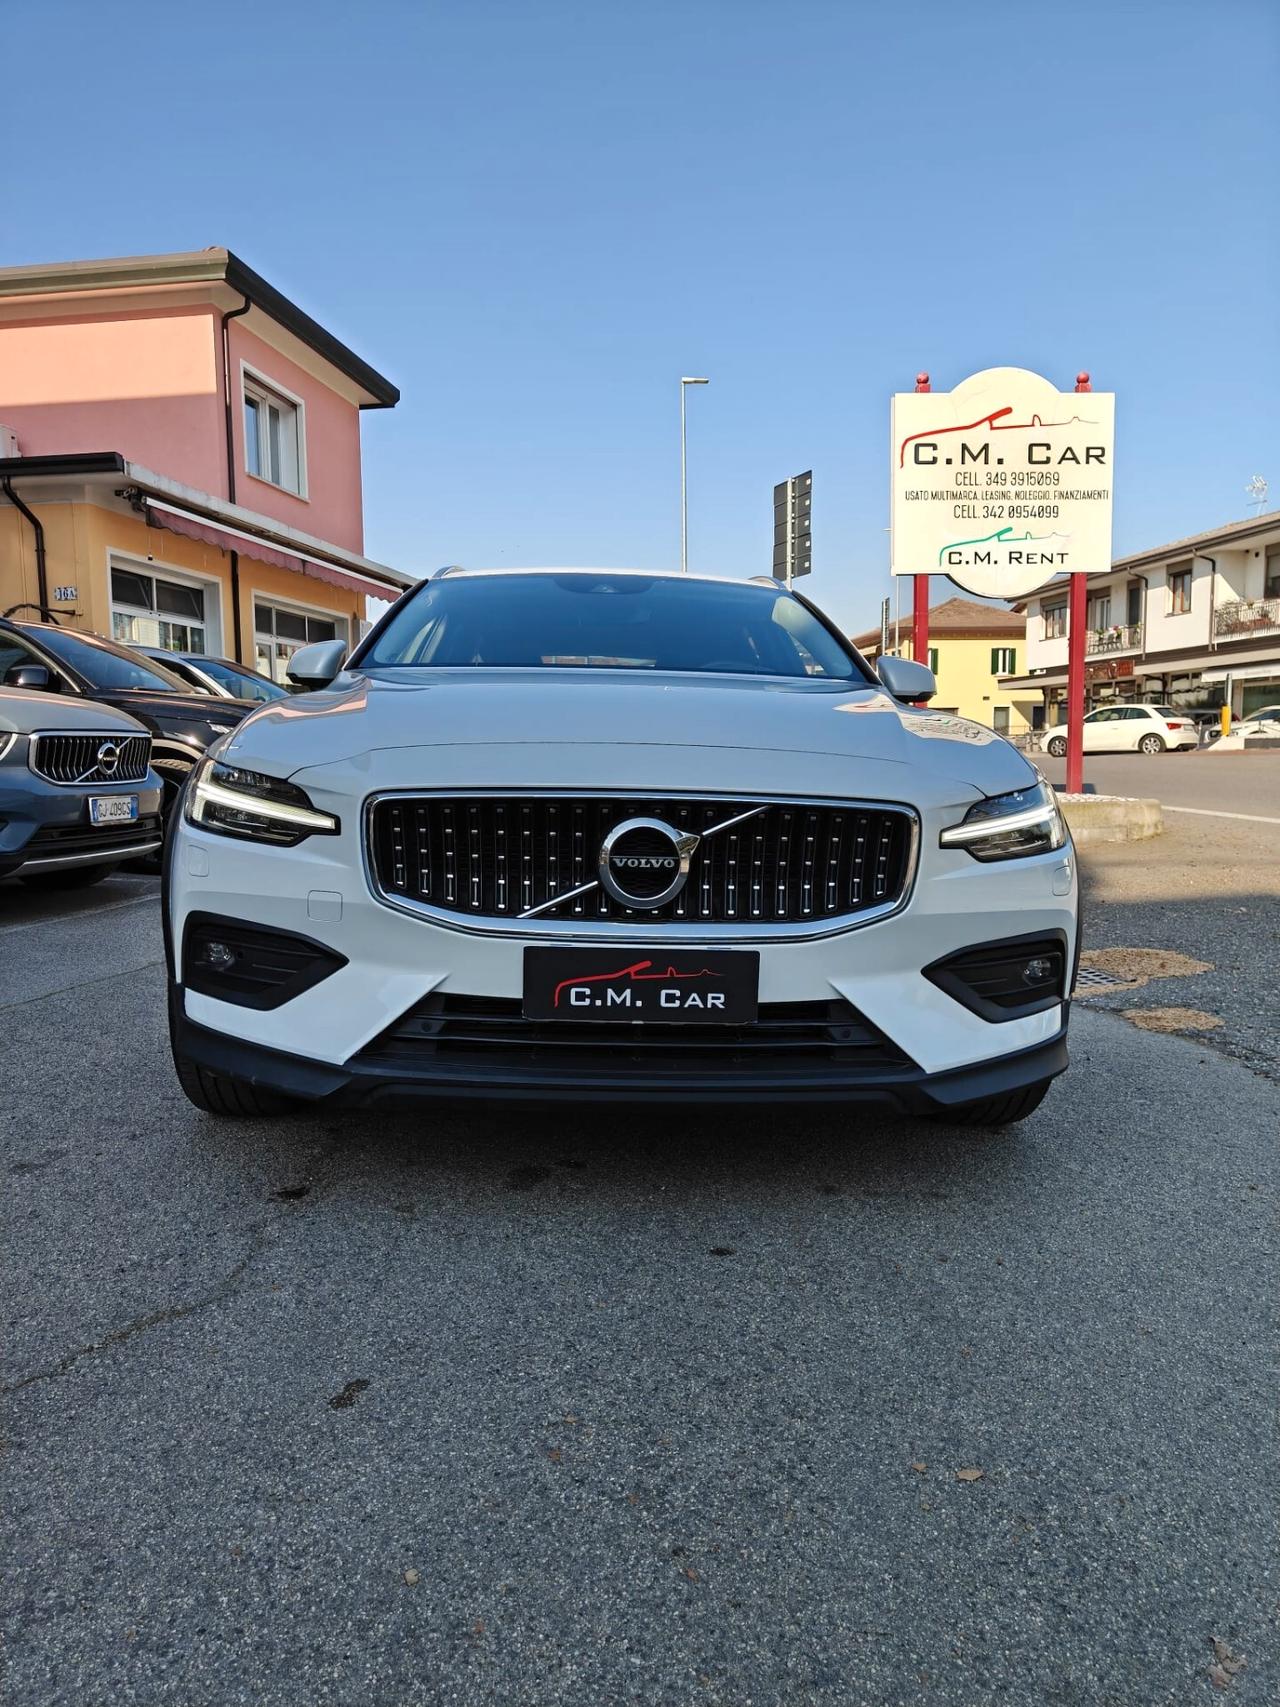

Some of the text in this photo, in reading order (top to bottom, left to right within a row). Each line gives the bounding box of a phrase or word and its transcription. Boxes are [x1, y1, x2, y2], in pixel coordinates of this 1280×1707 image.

[913, 442, 1005, 466] C.M.
[985, 471, 1007, 487] 349
[1010, 471, 1060, 487] 3915069
[905, 490, 929, 501] USATO
[1053, 489, 1109, 501] FINANZIAMENTI
[982, 505, 1005, 519] 342
[1008, 505, 1060, 519] 0954099
[948, 552, 998, 565] C.M.
[612, 858, 676, 868] VOLVO
[570, 987, 643, 1008] C.M.
